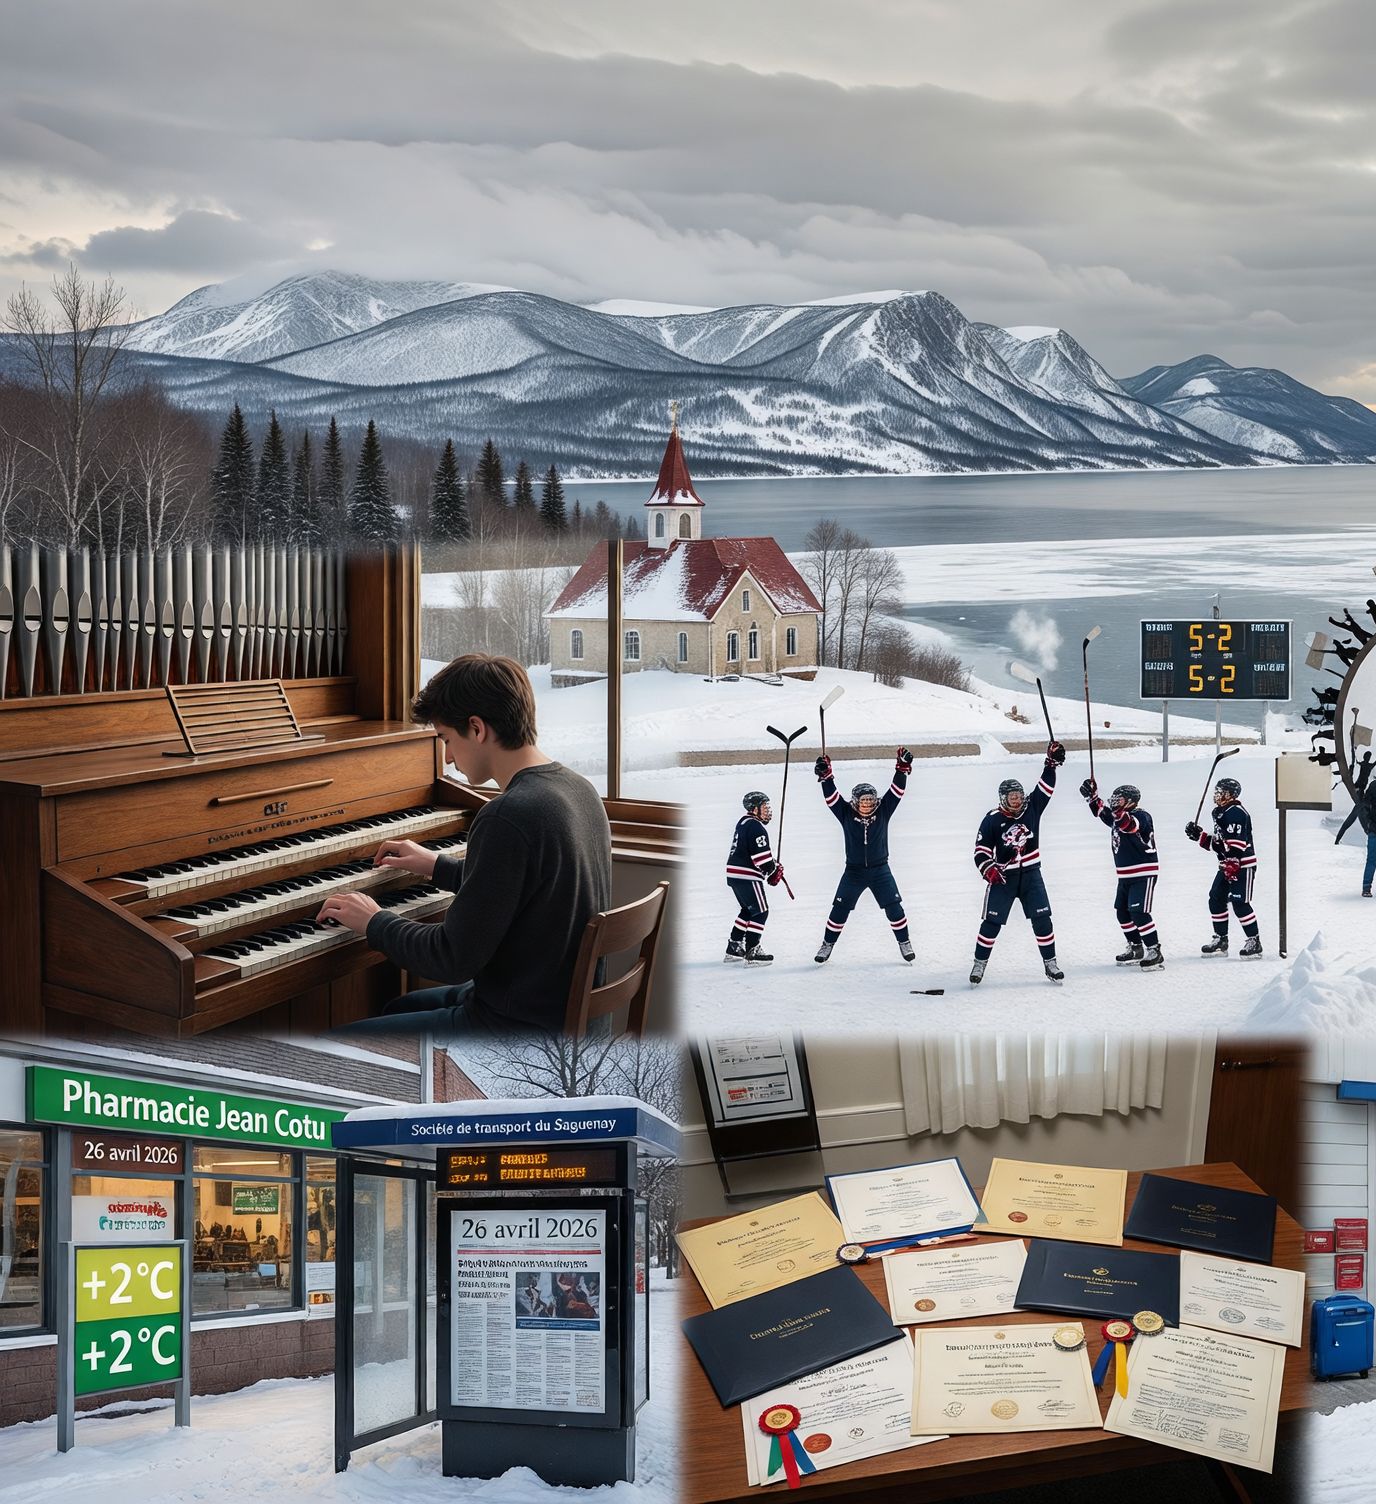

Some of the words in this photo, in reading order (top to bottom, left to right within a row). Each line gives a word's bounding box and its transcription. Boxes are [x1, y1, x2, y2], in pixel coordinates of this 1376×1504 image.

[63, 1078, 210, 1127] Pharmacie
[215, 1100, 268, 1134] Jean
[274, 1109, 326, 1141] Cotu
[457, 1122, 472, 1134] de
[474, 1121, 531, 1136] transport
[535, 1119, 551, 1132] du
[554, 1118, 617, 1133] Saguenay
[84, 1141, 105, 1160] 26
[109, 1144, 141, 1162] avril
[144, 1146, 178, 1165] 2026
[462, 1218, 487, 1239] 26
[494, 1217, 540, 1239] avril
[546, 1217, 598, 1238] 2026
[82, 1260, 174, 1305] +2°C
[82, 1325, 176, 1374] +2°C
